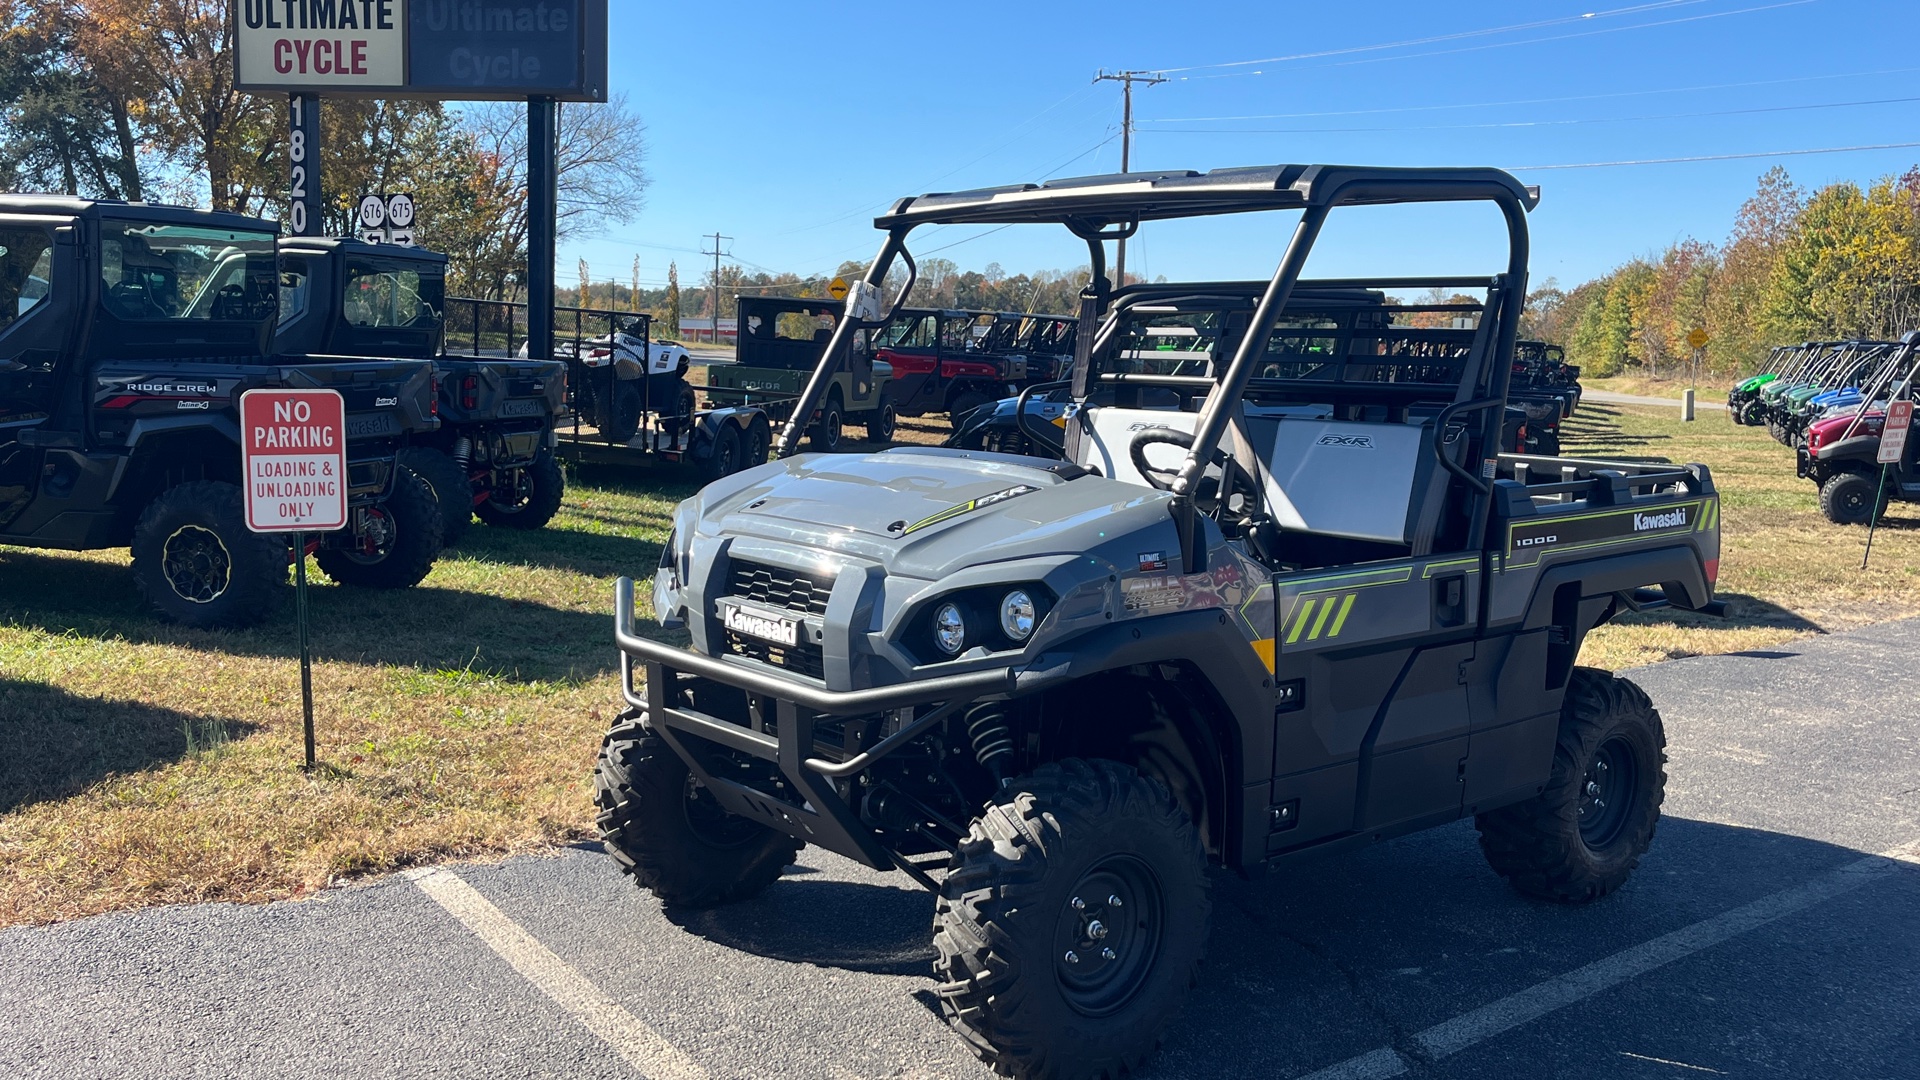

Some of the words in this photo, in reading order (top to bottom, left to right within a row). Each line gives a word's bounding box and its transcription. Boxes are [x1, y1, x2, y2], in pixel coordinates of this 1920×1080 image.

[245, 0, 393, 29] ULTIMATE
[426, 0, 568, 31] Ultimate
[274, 39, 367, 74] CYCLE
[450, 47, 541, 85] Cycle
[364, 204, 381, 219] 676
[392, 203, 410, 218] 675
[127, 384, 172, 392] RIDGE
[176, 384, 217, 393] CREW
[274, 401, 311, 422] NO
[1895, 406, 1906, 415] NO
[346, 415, 391, 434] wasaki
[254, 426, 333, 448] PARKING
[1317, 435, 1372, 447] FXR
[257, 462, 316, 477] LOADING
[322, 461, 333, 477] &
[257, 482, 335, 498] UNLOADING
[279, 502, 314, 518] ONLY
[1633, 508, 1686, 531] Kawasaki
[1516, 535, 1557, 547] 1000
[724, 605, 797, 645] Kawasaki
